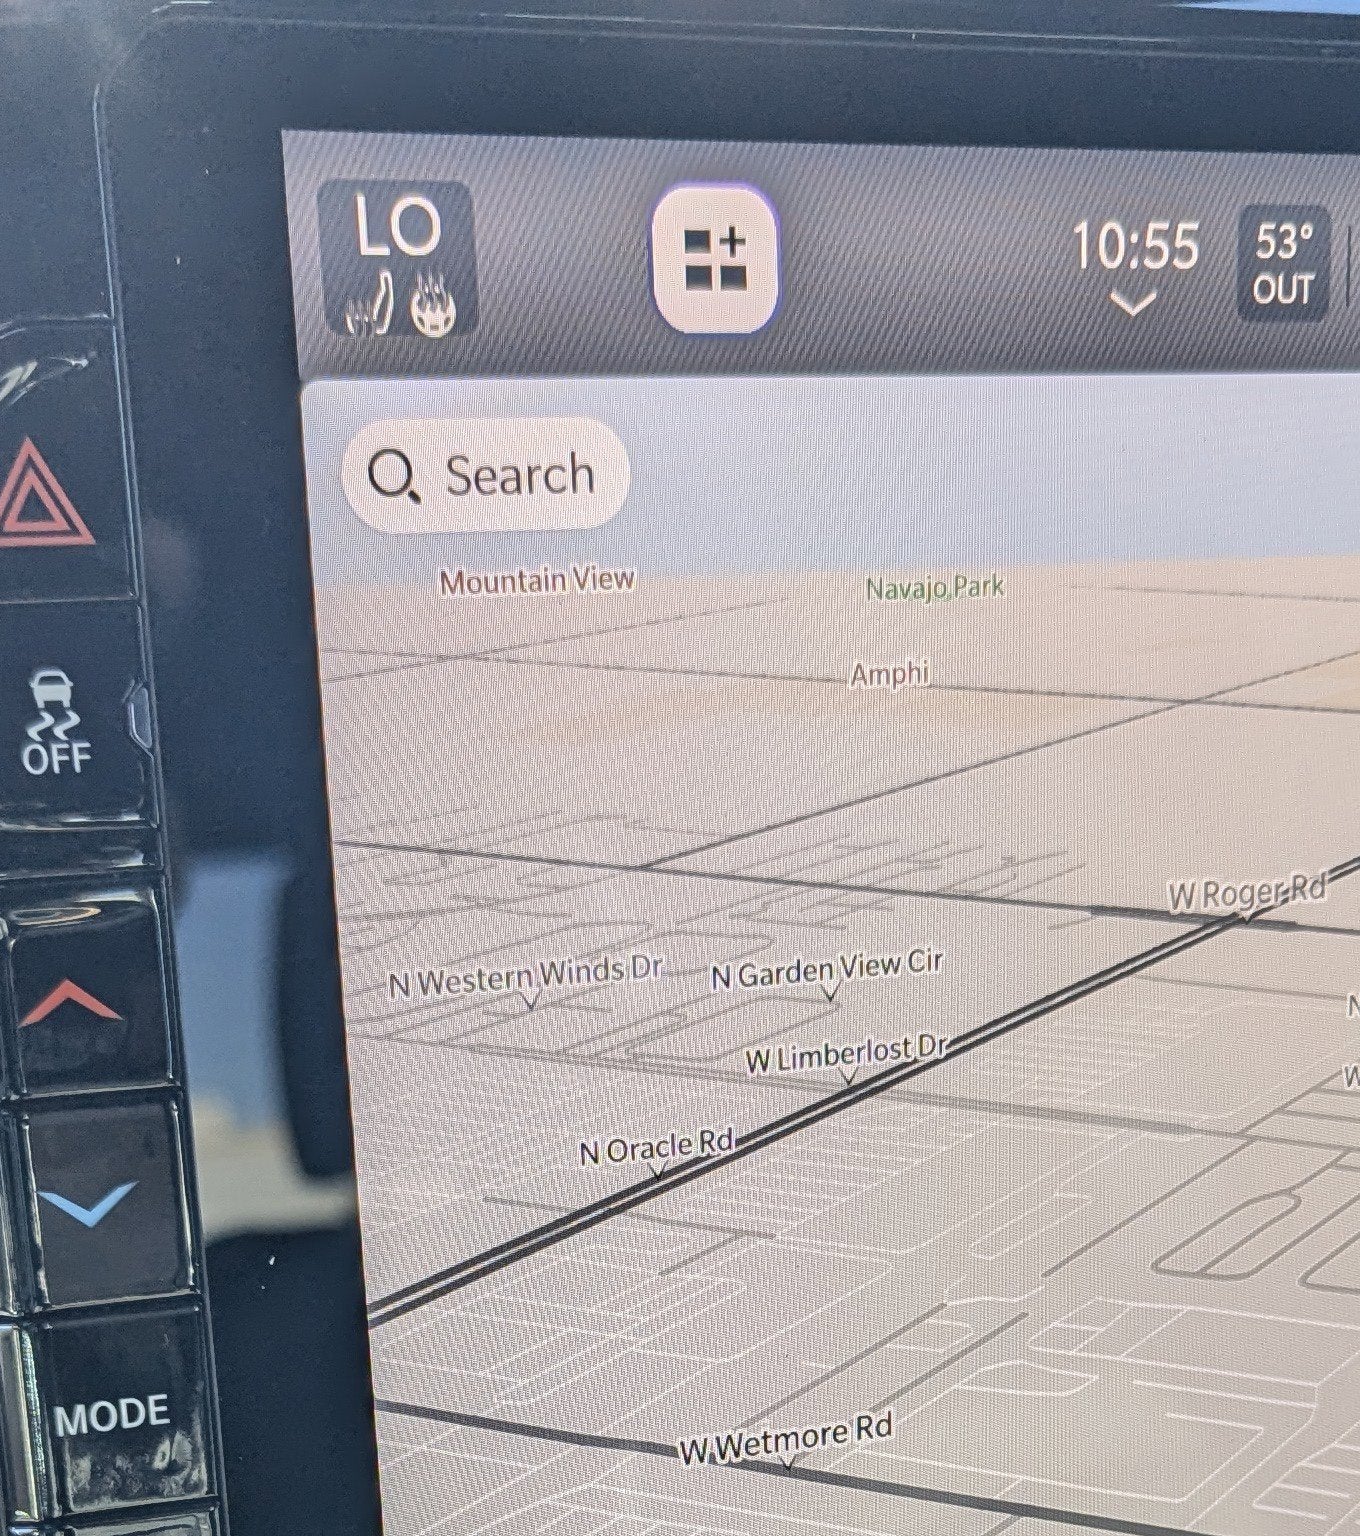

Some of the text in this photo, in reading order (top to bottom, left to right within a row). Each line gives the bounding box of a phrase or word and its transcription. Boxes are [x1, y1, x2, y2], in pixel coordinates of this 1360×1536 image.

[355, 192, 442, 258] LO
[1072, 221, 1200, 271] 10:55
[1256, 221, 1314, 259] 53°
[1252, 274, 1315, 308] OUT
[445, 451, 597, 498] Search
[439, 565, 637, 596] Mountain View
[865, 573, 1006, 604] Navajo Park
[849, 660, 932, 690] Amphi
[20, 741, 93, 776] OFF
[1168, 871, 1328, 914] W Roger Rd
[389, 954, 664, 999] N Western Winds Dr
[711, 947, 945, 990] N Garden View Cir
[744, 1033, 948, 1074] W Limberlost Dr
[579, 1127, 734, 1166] N Oracle Rd
[53, 1393, 172, 1438] MODE
[679, 1410, 895, 1466] W Wetmore Rd
